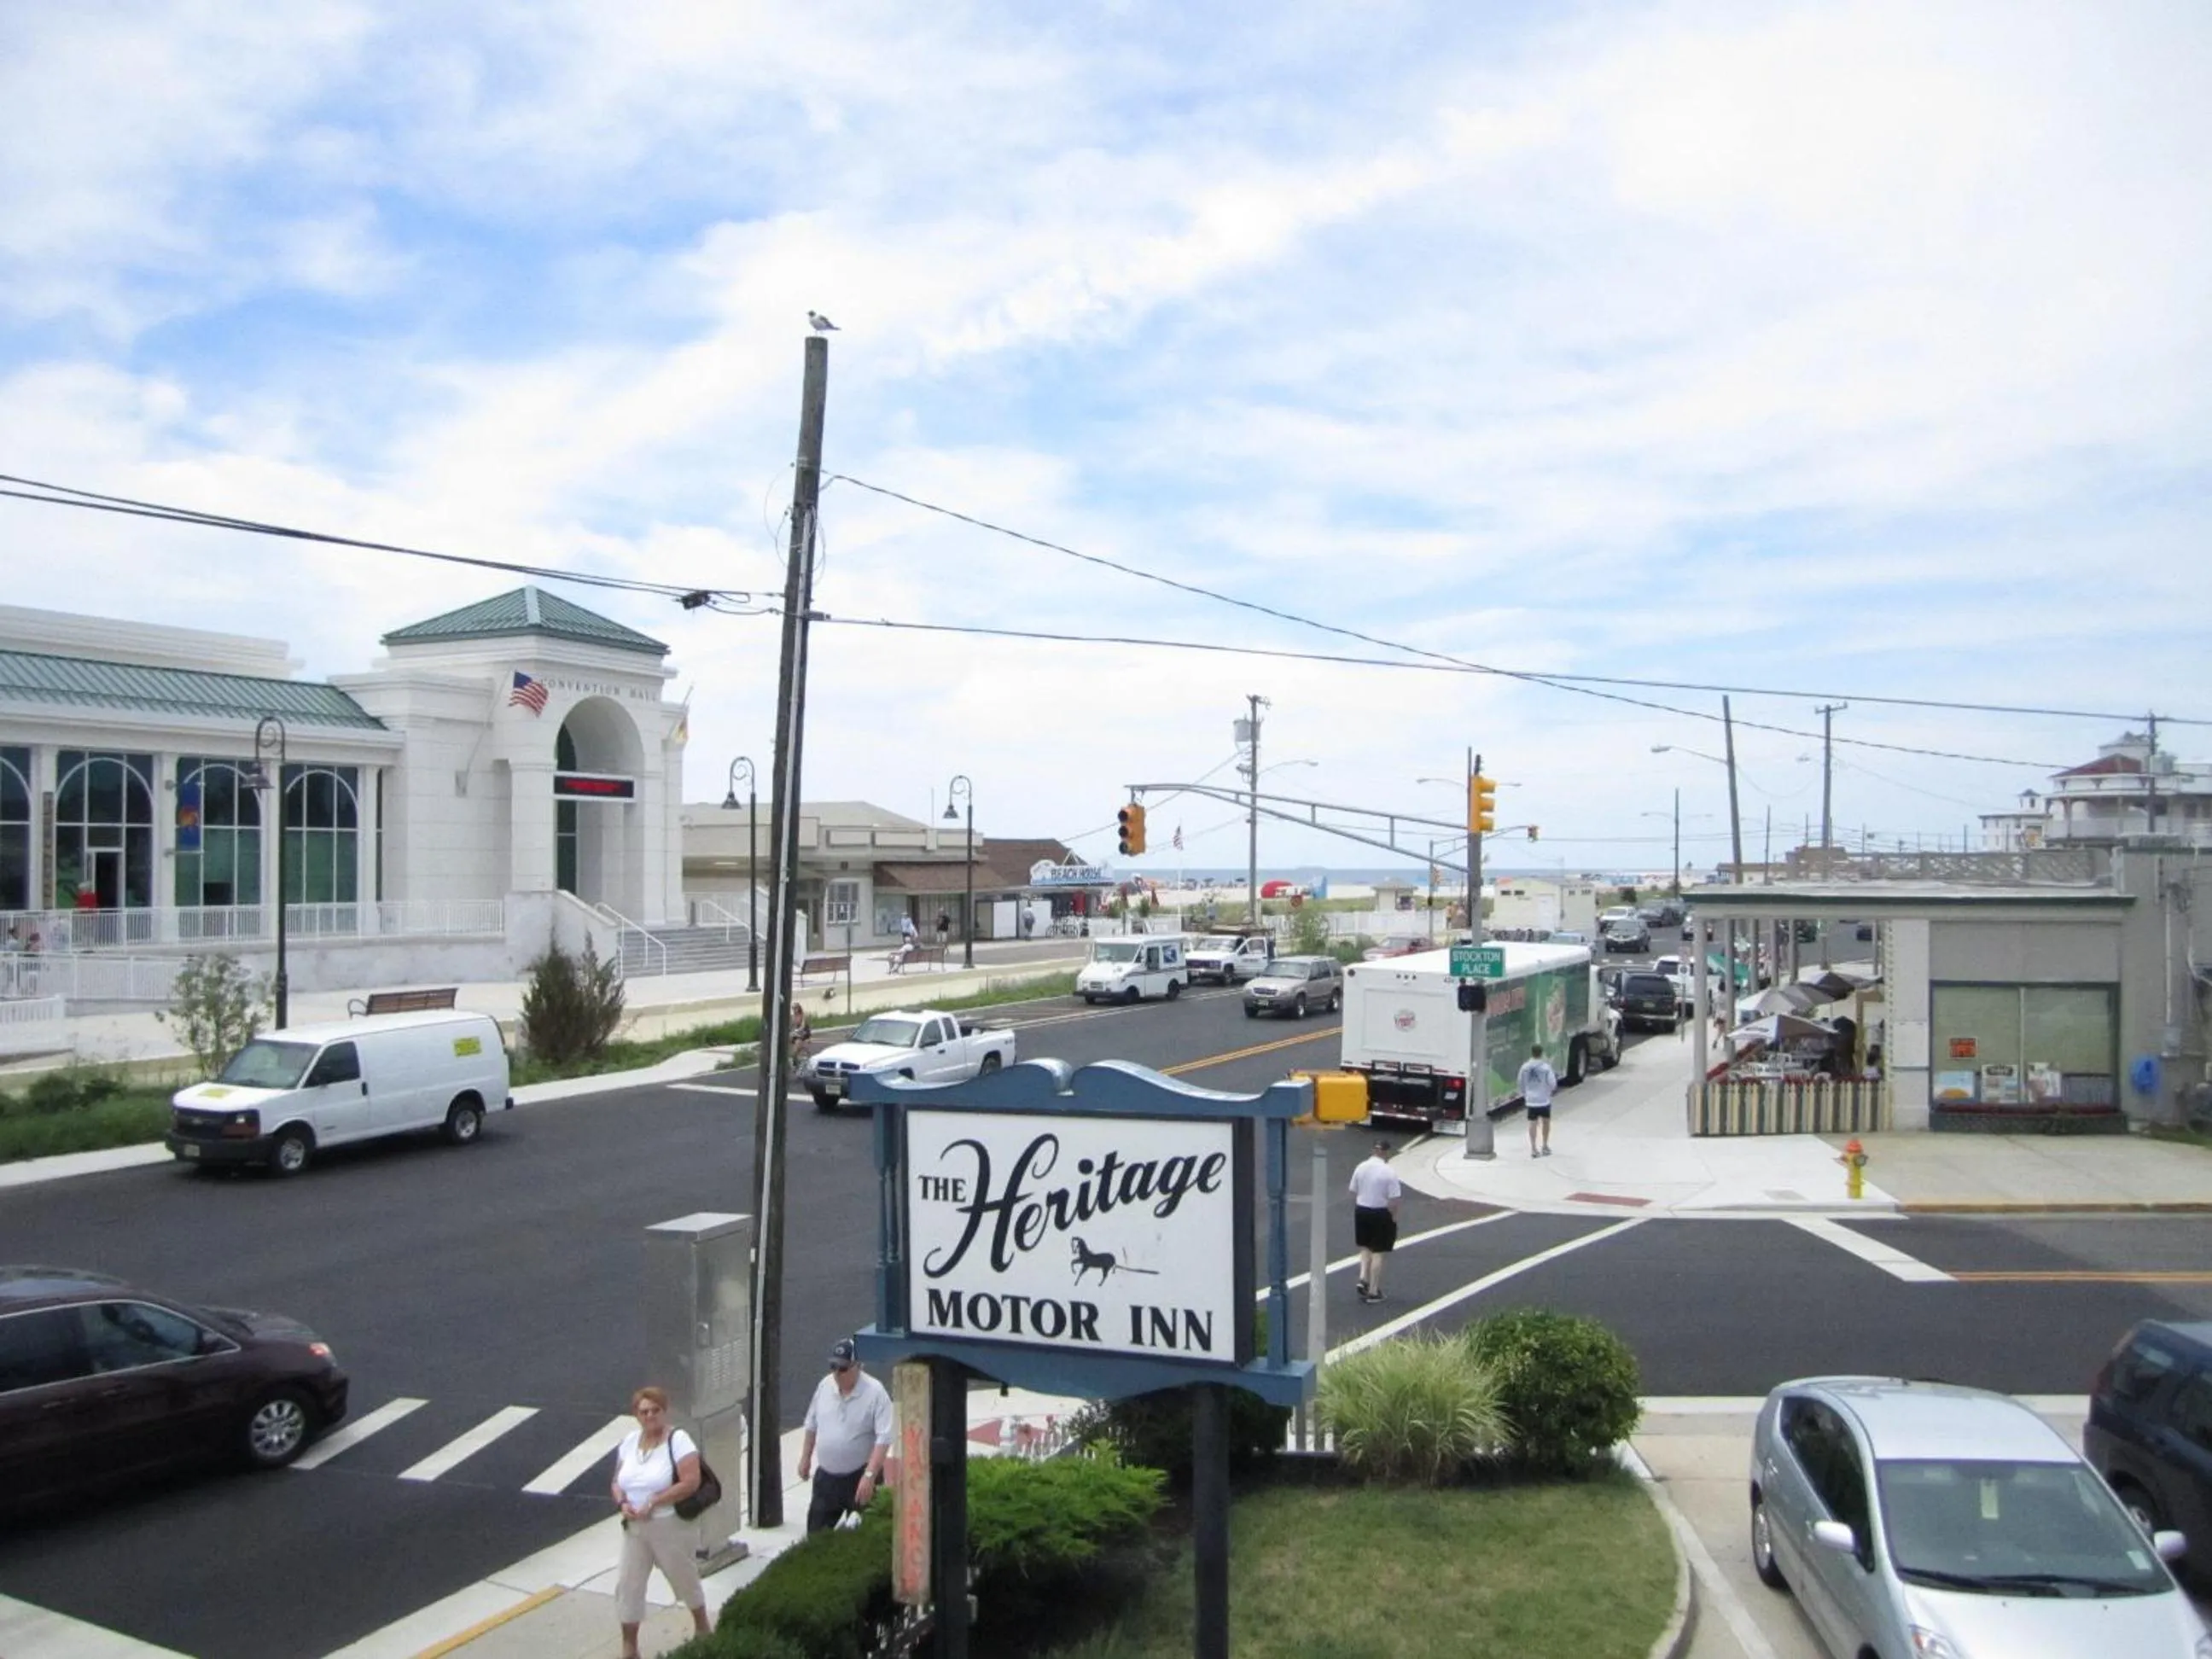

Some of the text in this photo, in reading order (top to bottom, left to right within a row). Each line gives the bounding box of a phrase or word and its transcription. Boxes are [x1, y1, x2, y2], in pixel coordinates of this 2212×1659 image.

[1452, 950, 1501, 963] STOCKTON
[1461, 963, 1490, 975] PLACE
[918, 1133, 1226, 1278] THE Heritage
[926, 1288, 1213, 1353] MOTOR INN
